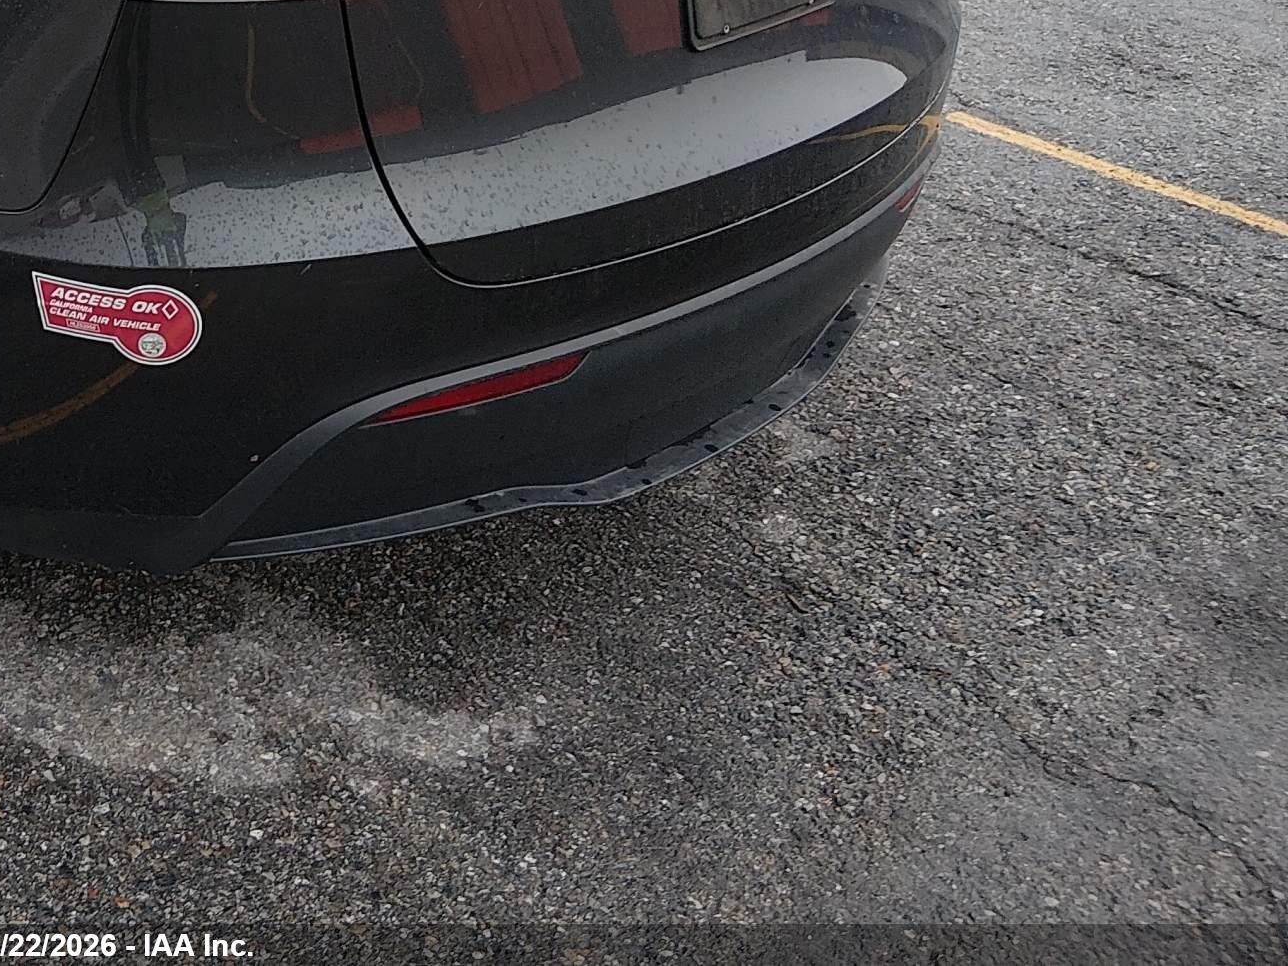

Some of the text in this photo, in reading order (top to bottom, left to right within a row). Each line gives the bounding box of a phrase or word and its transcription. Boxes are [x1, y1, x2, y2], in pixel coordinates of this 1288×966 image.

[49, 298, 93, 313] CALIFORNIA
[51, 287, 163, 315] ACCESS OK
[49, 306, 87, 321] CLEAN
[89, 314, 110, 325] AIR
[113, 318, 161, 332] VEHICLE
